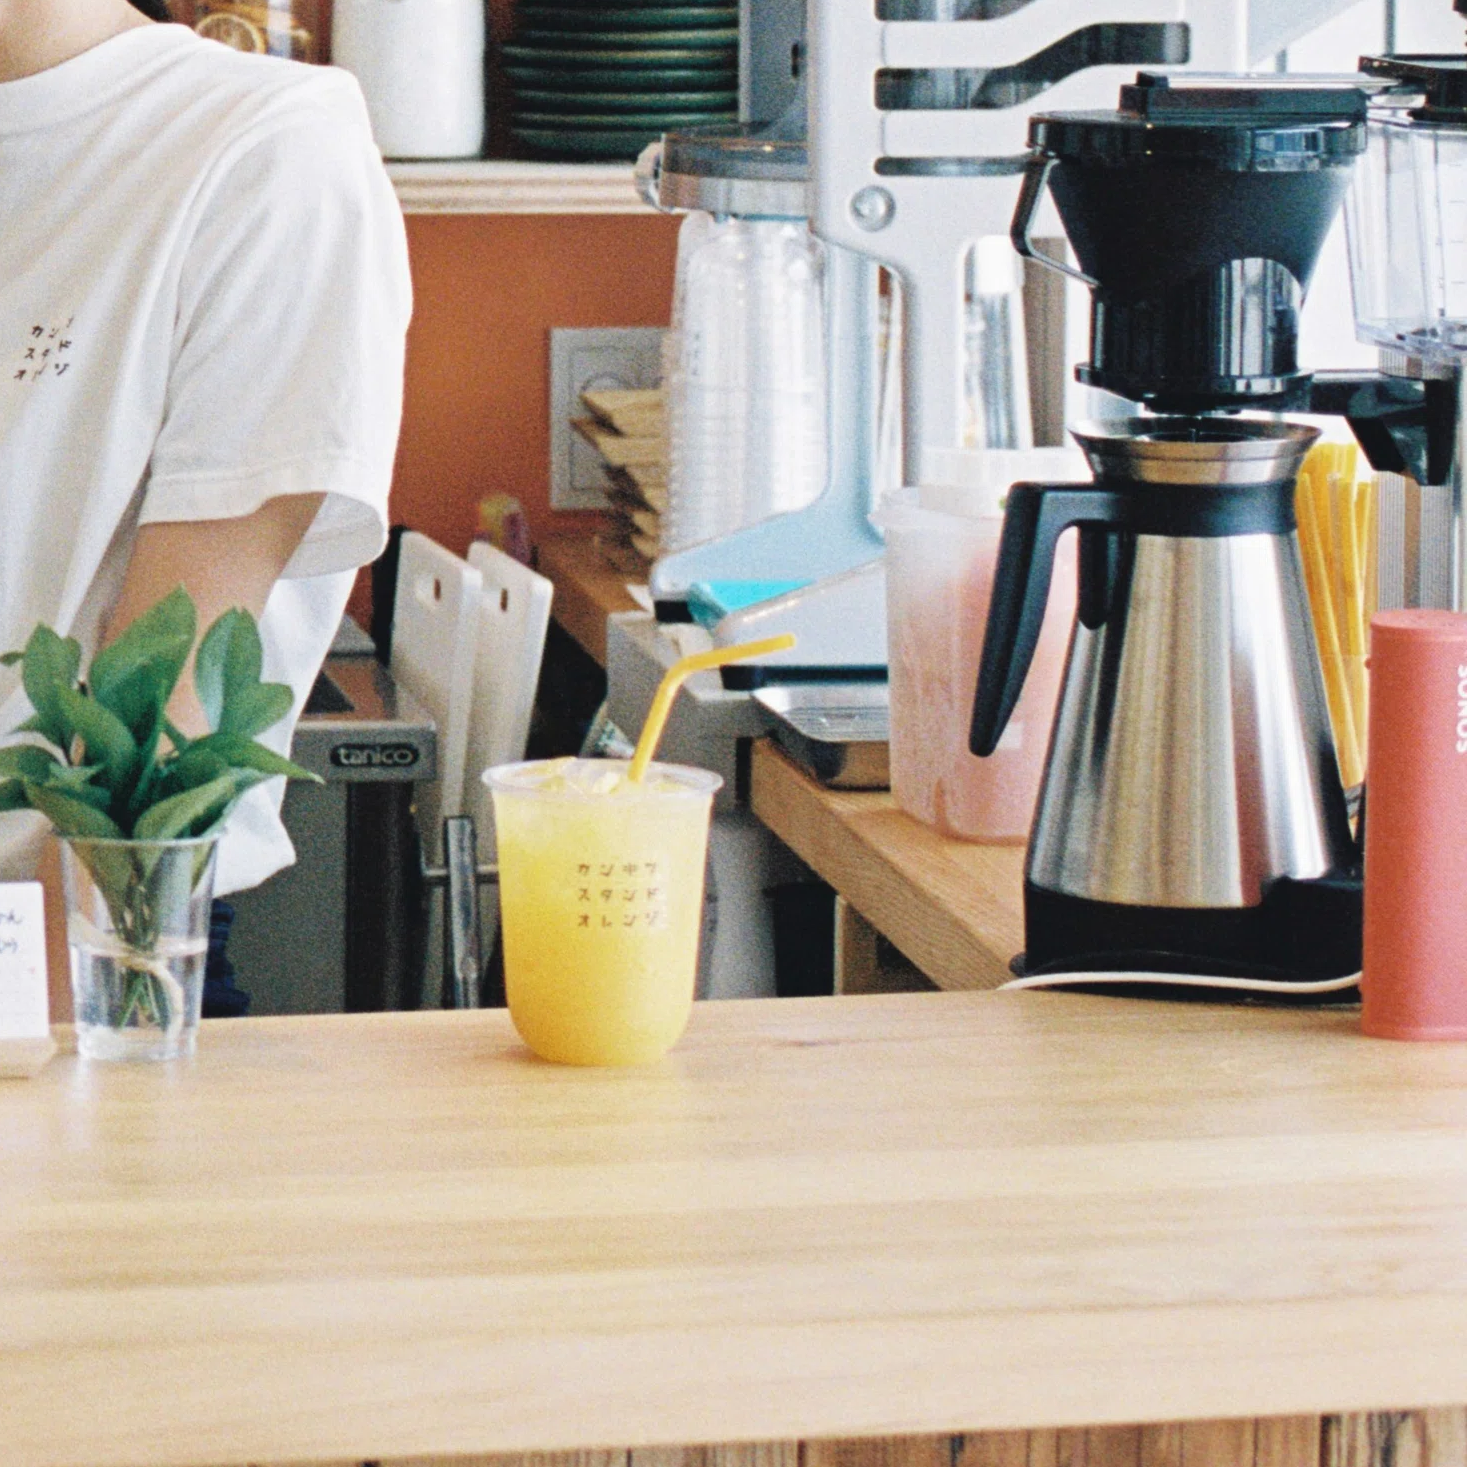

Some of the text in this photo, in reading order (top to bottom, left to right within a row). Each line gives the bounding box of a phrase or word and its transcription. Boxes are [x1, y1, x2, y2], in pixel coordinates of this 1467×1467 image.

[339, 746, 414, 765] tanico
[577, 887, 659, 903] スタンド
[577, 910, 659, 928] オレンジ
